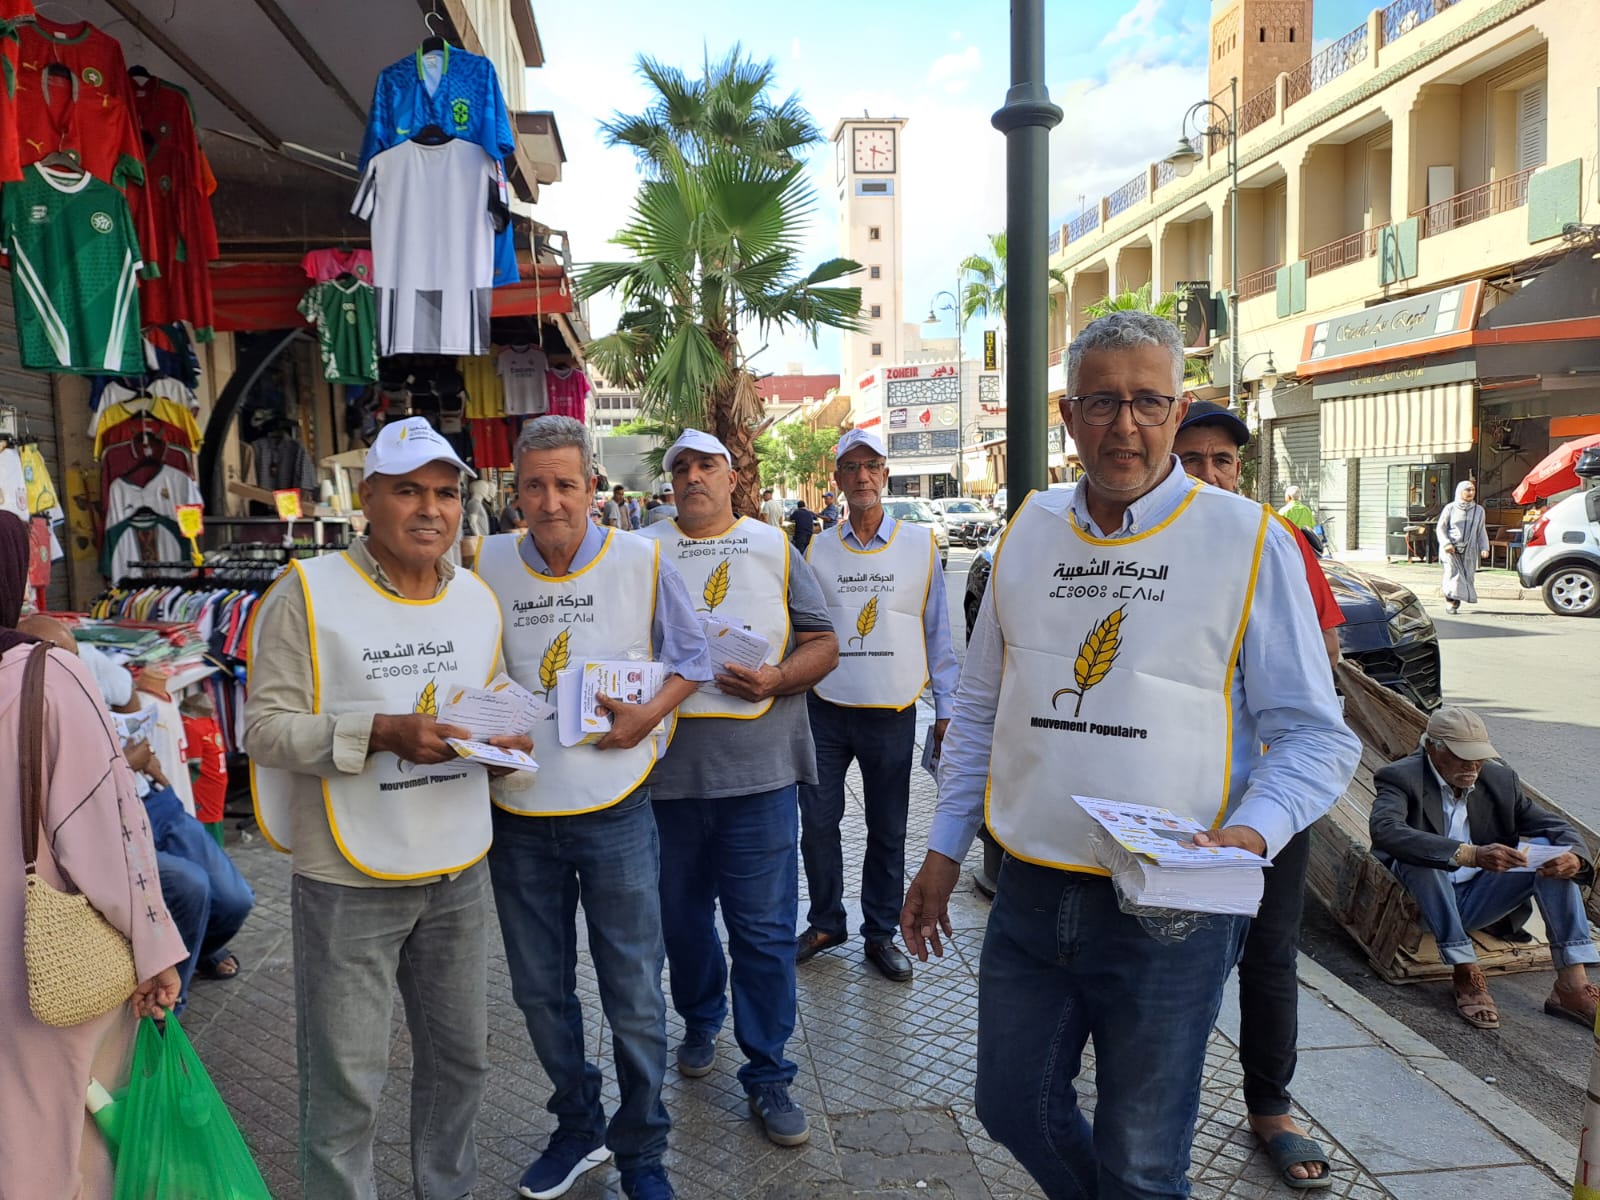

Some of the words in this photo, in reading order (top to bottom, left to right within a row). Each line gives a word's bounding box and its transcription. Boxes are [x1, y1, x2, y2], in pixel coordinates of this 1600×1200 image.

[1178, 290, 1188, 334] HOTE
[986, 332, 994, 363] HOTEL
[886, 367, 919, 380] ZOHEIR
[930, 365, 958, 378] وهير
[677, 538, 715, 548] الشعبية
[837, 572, 868, 584] الشعبية
[869, 573, 894, 582] الحركة
[1053, 558, 1110, 581] الشعبية
[1112, 560, 1169, 581] الحركة
[512, 594, 554, 613] الشعبية
[556, 594, 593, 607] الحركة
[362, 643, 415, 663] الشعبية
[418, 640, 455, 657] الحركة
[1030, 716, 1087, 733] Mouvement
[1090, 723, 1148, 739] Populaire
[379, 776, 429, 792] Mouvement
